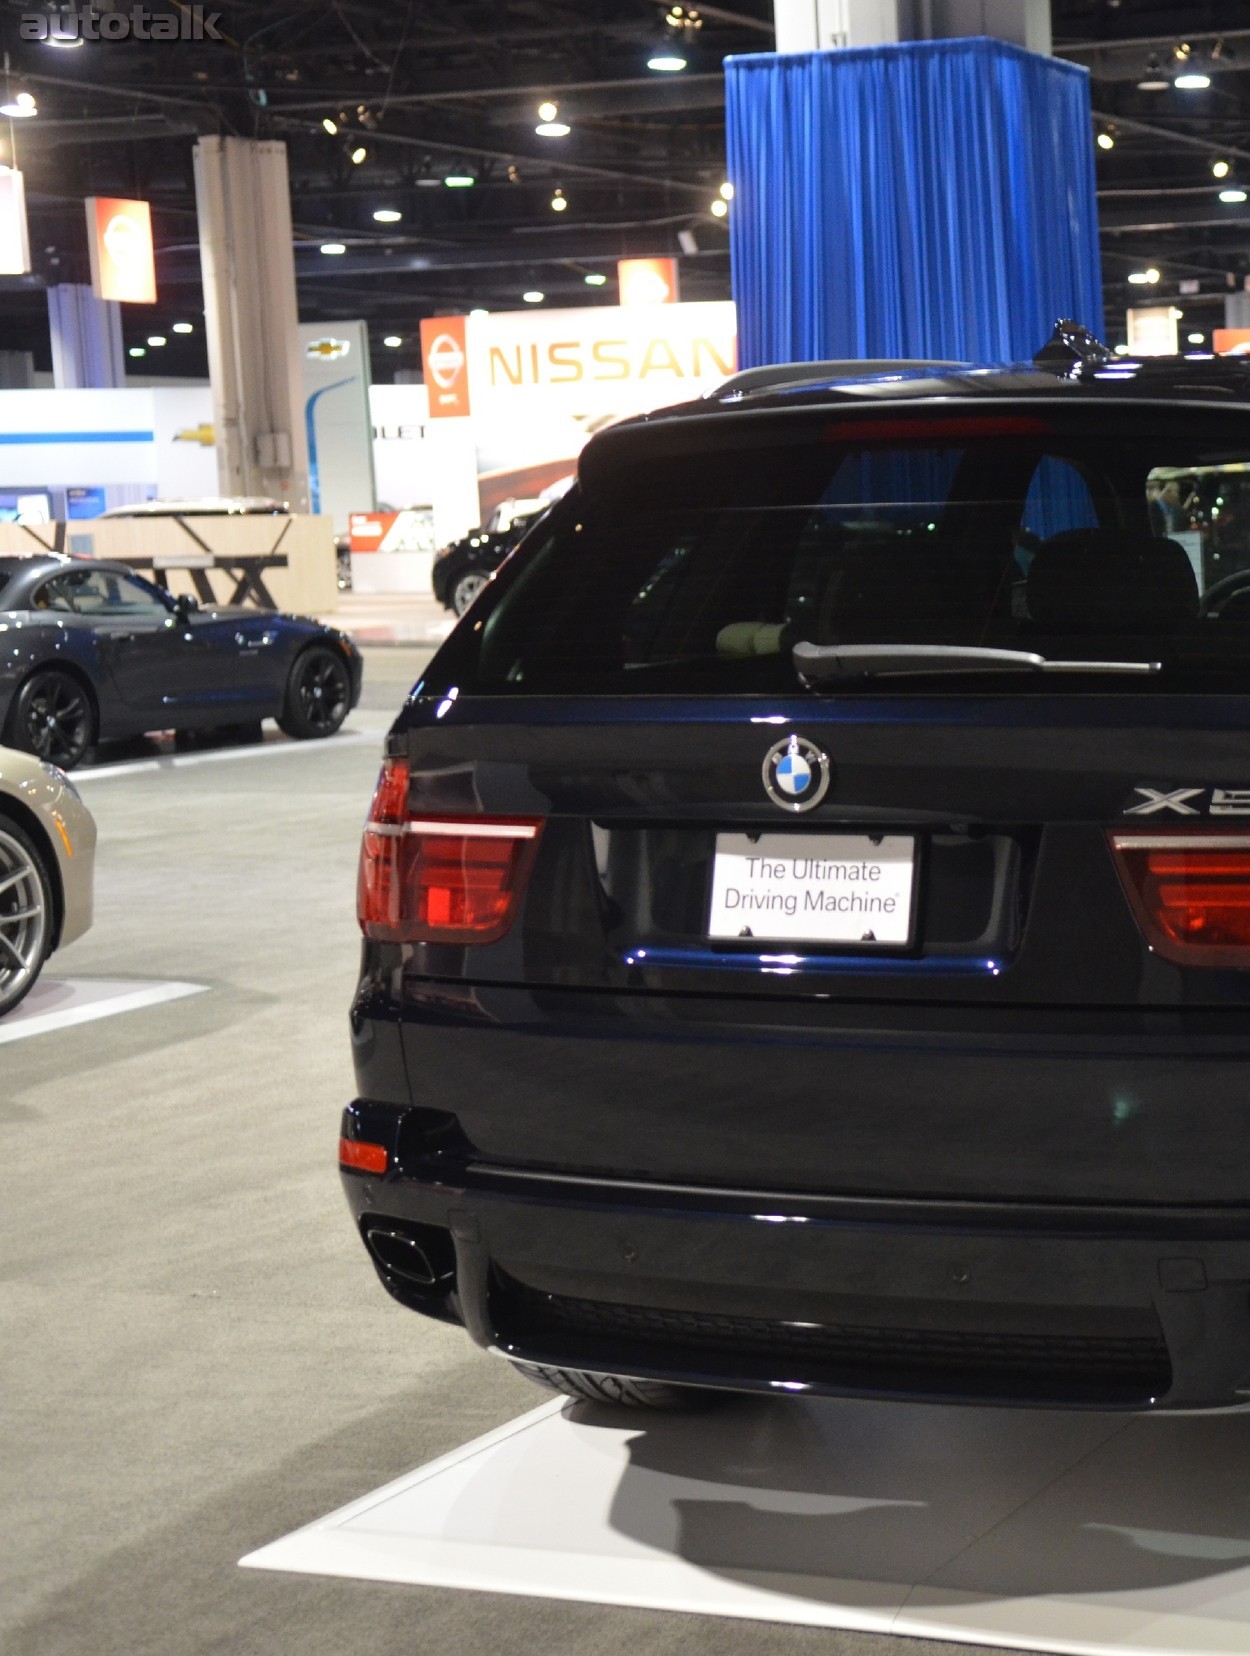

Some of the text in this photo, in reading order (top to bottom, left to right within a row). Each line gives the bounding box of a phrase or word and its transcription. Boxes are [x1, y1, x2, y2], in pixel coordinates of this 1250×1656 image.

[489, 337, 737, 386] NISSAN
[373, 425, 426, 440] LET
[745, 857, 882, 881] The Ultimate
[724, 888, 798, 915] Driving
